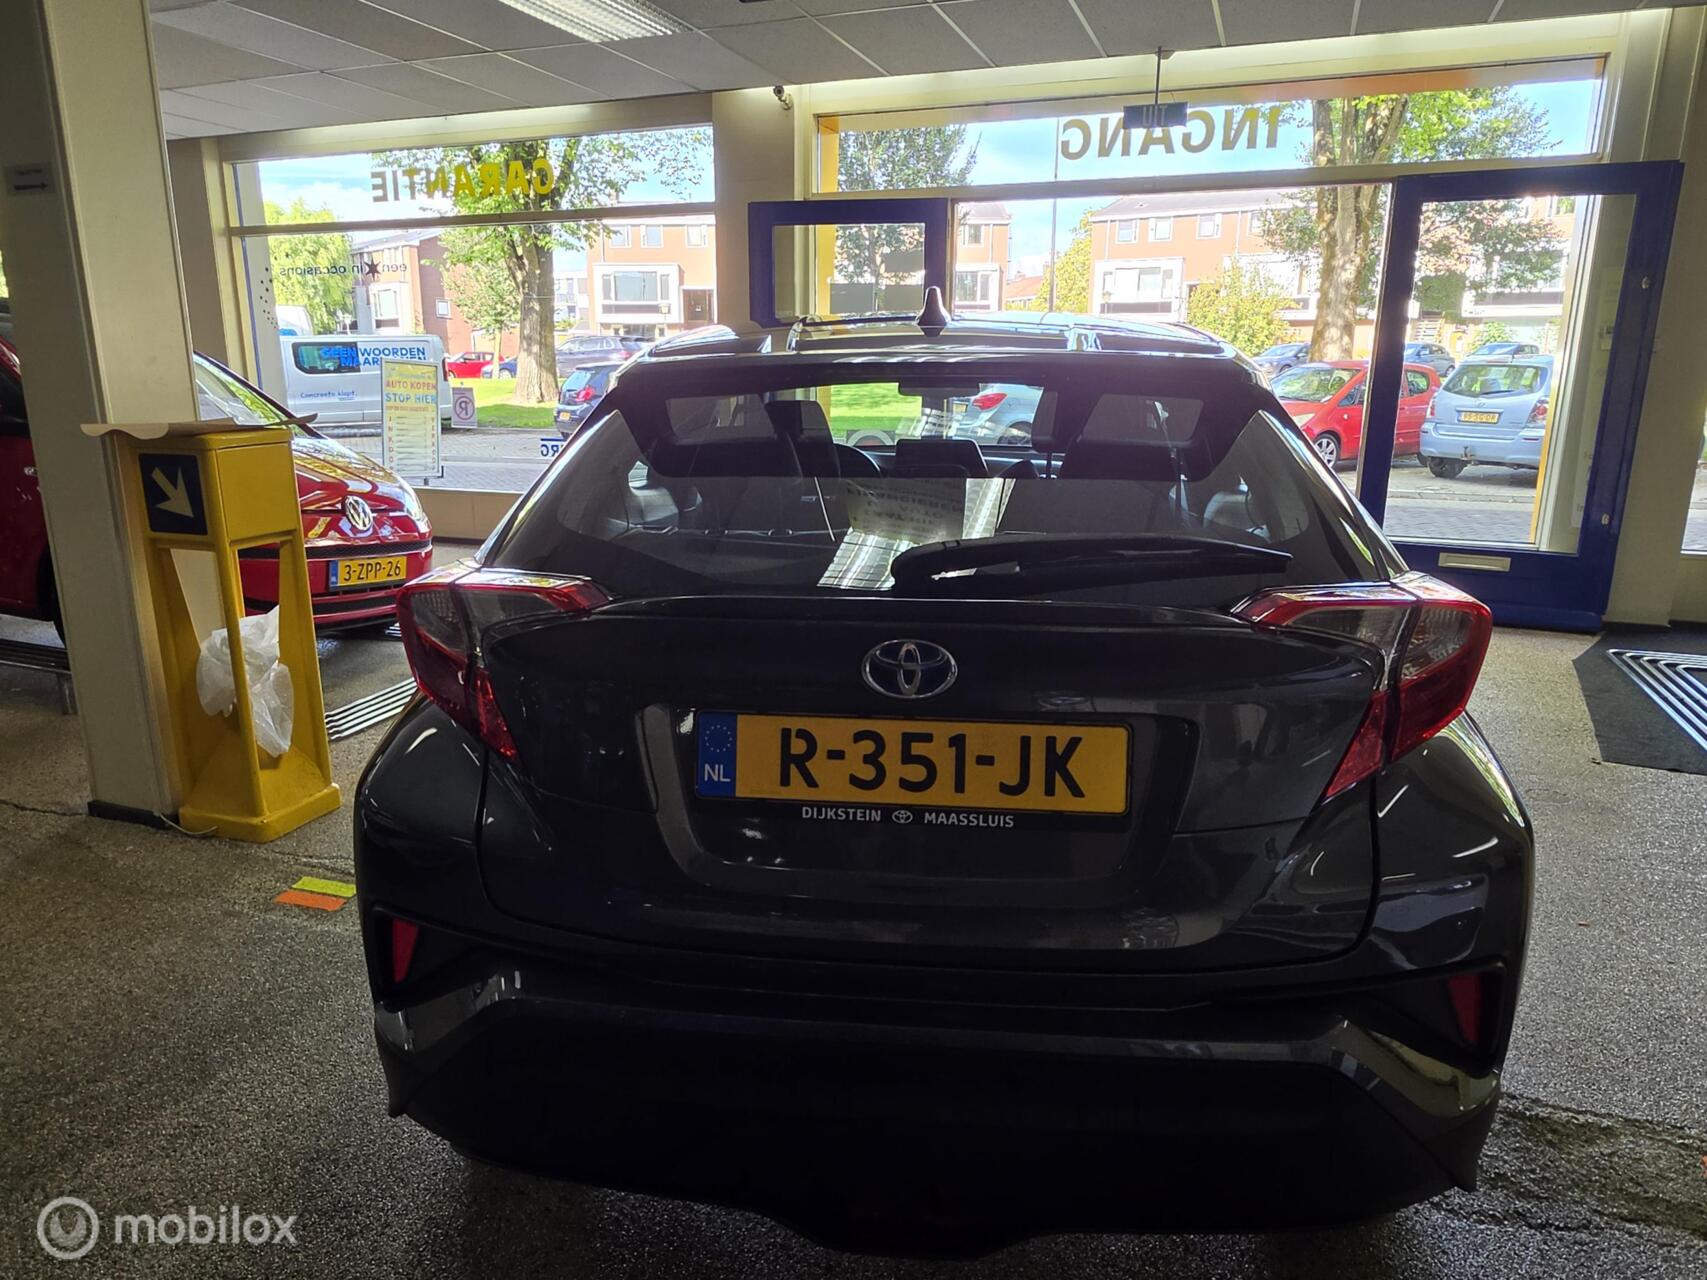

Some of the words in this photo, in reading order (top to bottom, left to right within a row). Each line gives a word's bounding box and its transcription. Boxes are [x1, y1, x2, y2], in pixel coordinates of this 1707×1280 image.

[1142, 104, 1168, 127] UIT
[360, 347, 426, 357] WOORDEN
[385, 380, 409, 390] AUTO
[410, 382, 437, 391] KOPEN
[385, 393, 411, 403] STOP
[343, 560, 401, 582] 3-ZPP-26
[703, 763, 731, 783] NL
[779, 727, 1086, 799] R-351-JK
[801, 806, 882, 823] DIJKSTEIN
[924, 811, 1015, 829] MAASSLUIS
